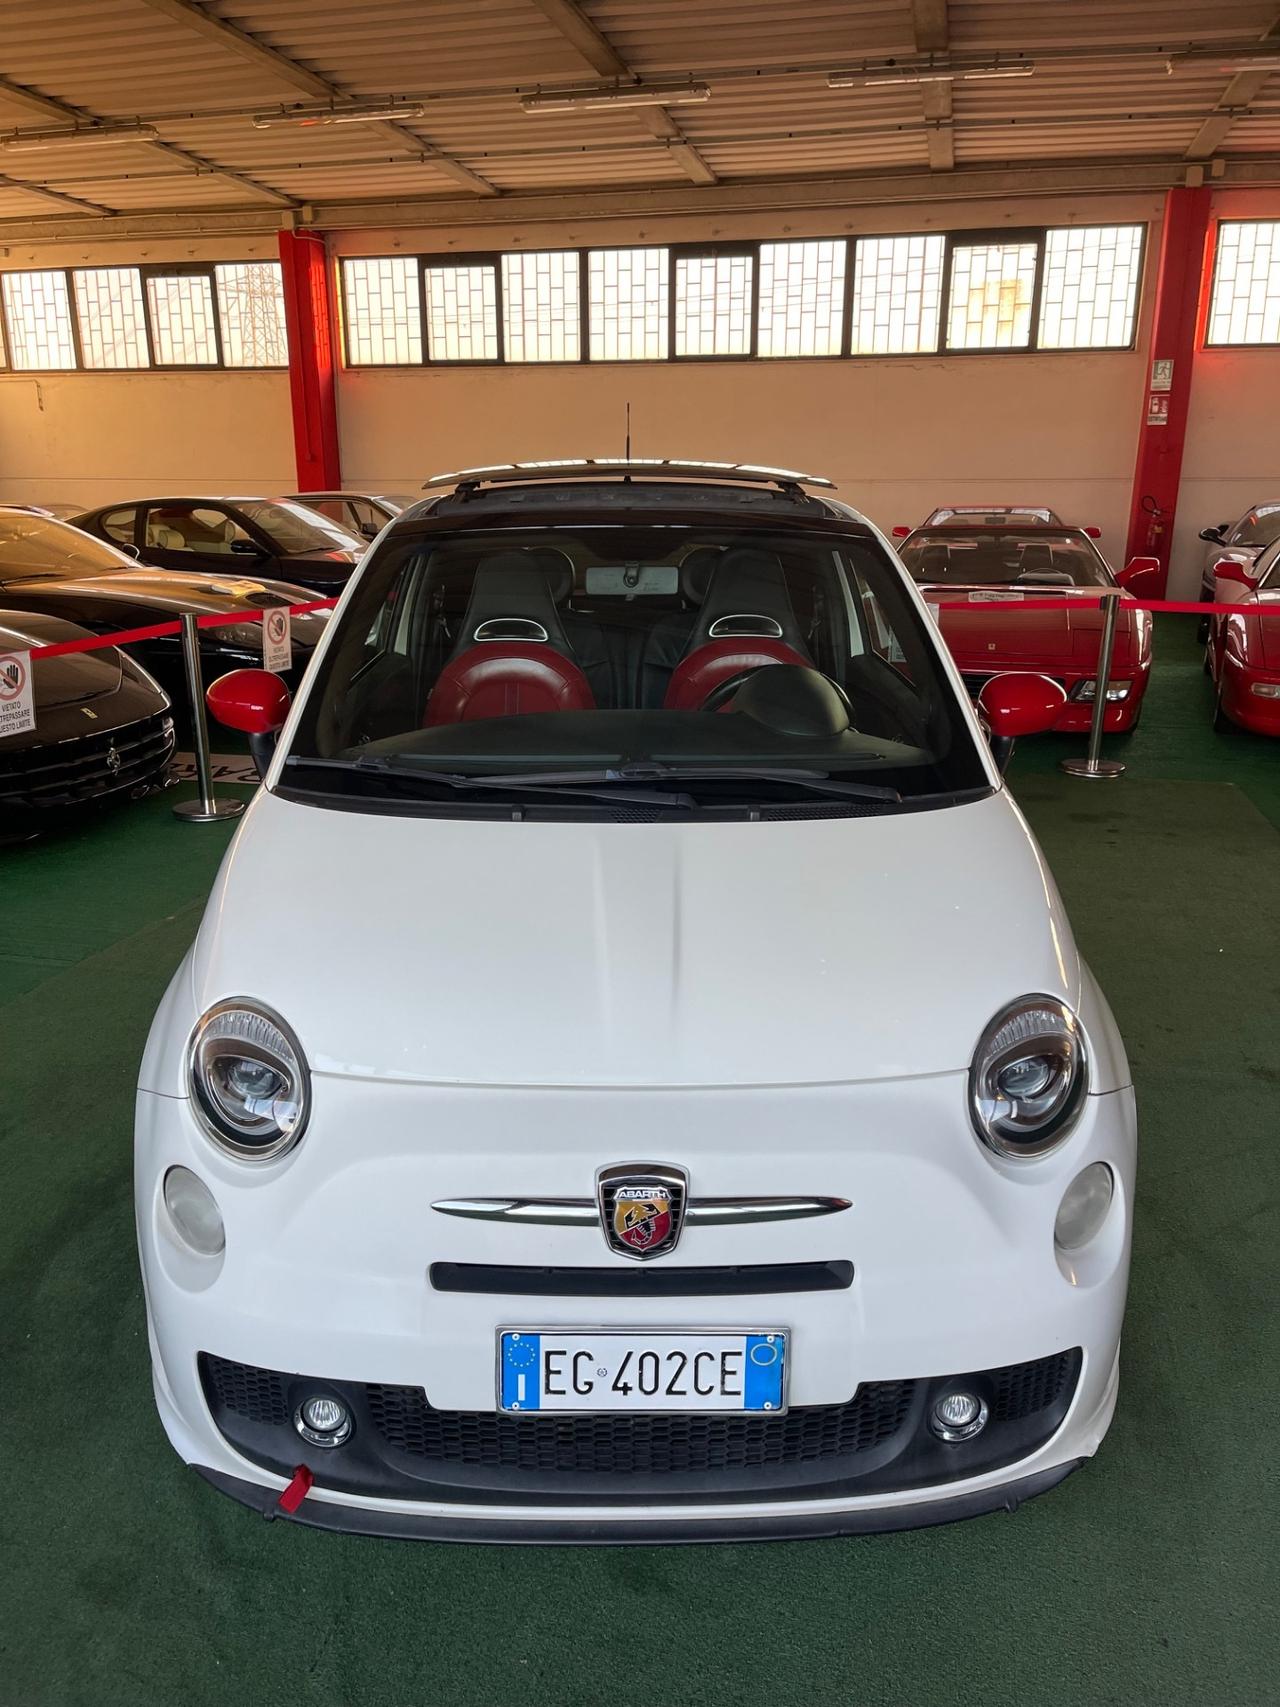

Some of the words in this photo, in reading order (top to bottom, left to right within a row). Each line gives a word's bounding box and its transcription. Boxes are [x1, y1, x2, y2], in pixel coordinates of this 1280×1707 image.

[2, 700, 21, 712] VIETATO
[619, 1190, 667, 1198] ABARTH
[544, 1350, 595, 1396] EG
[611, 1350, 743, 1396] 402CE
